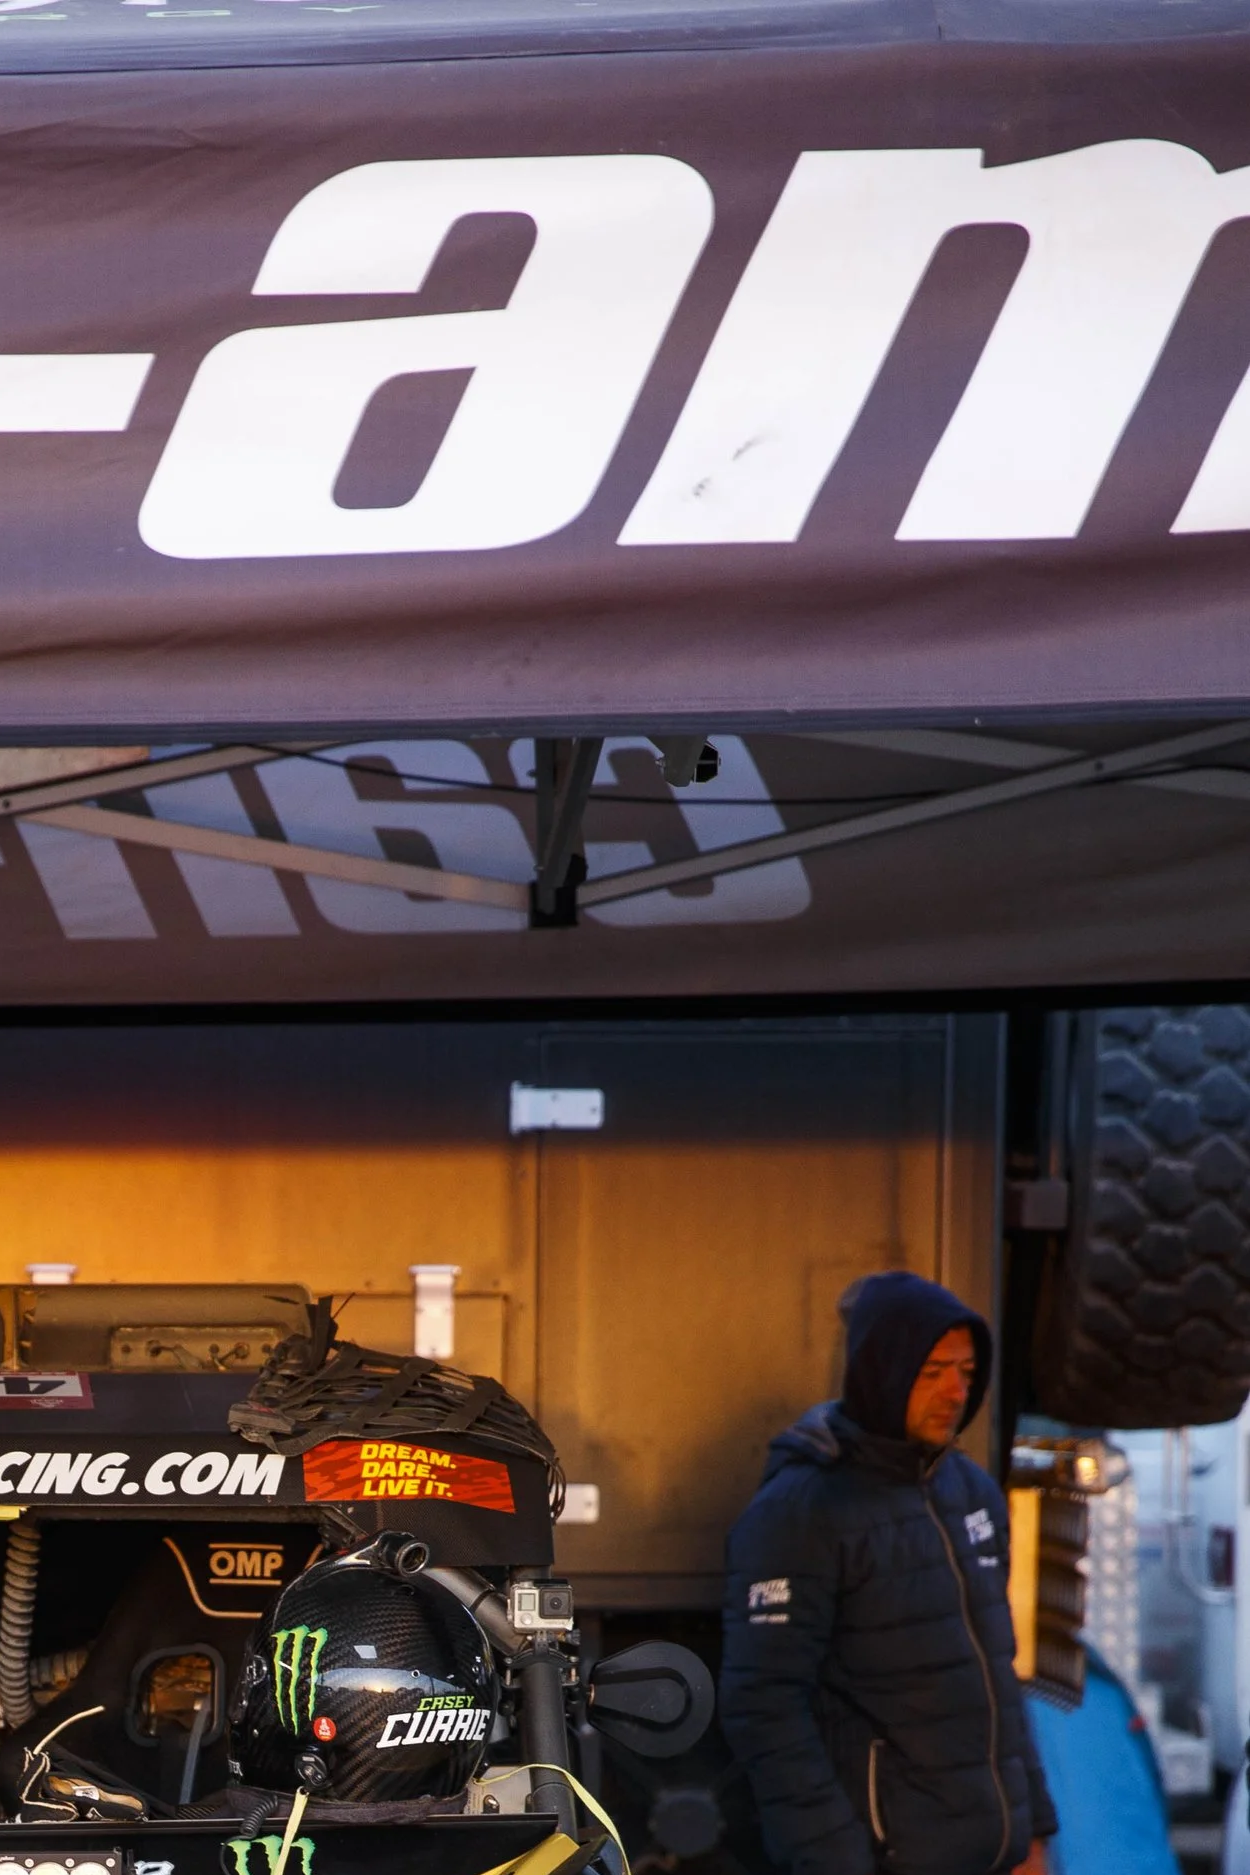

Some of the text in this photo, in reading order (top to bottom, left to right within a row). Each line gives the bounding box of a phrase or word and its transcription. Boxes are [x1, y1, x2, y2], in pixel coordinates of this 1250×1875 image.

[360, 1443, 457, 1469] DREAM.
[361, 1461, 437, 1480] DARE.
[363, 1479, 453, 1497] LIVE IT.
[210, 1550, 283, 1577] OMP
[417, 1695, 474, 1711] CASEY
[376, 1708, 491, 1748] CURRIE
